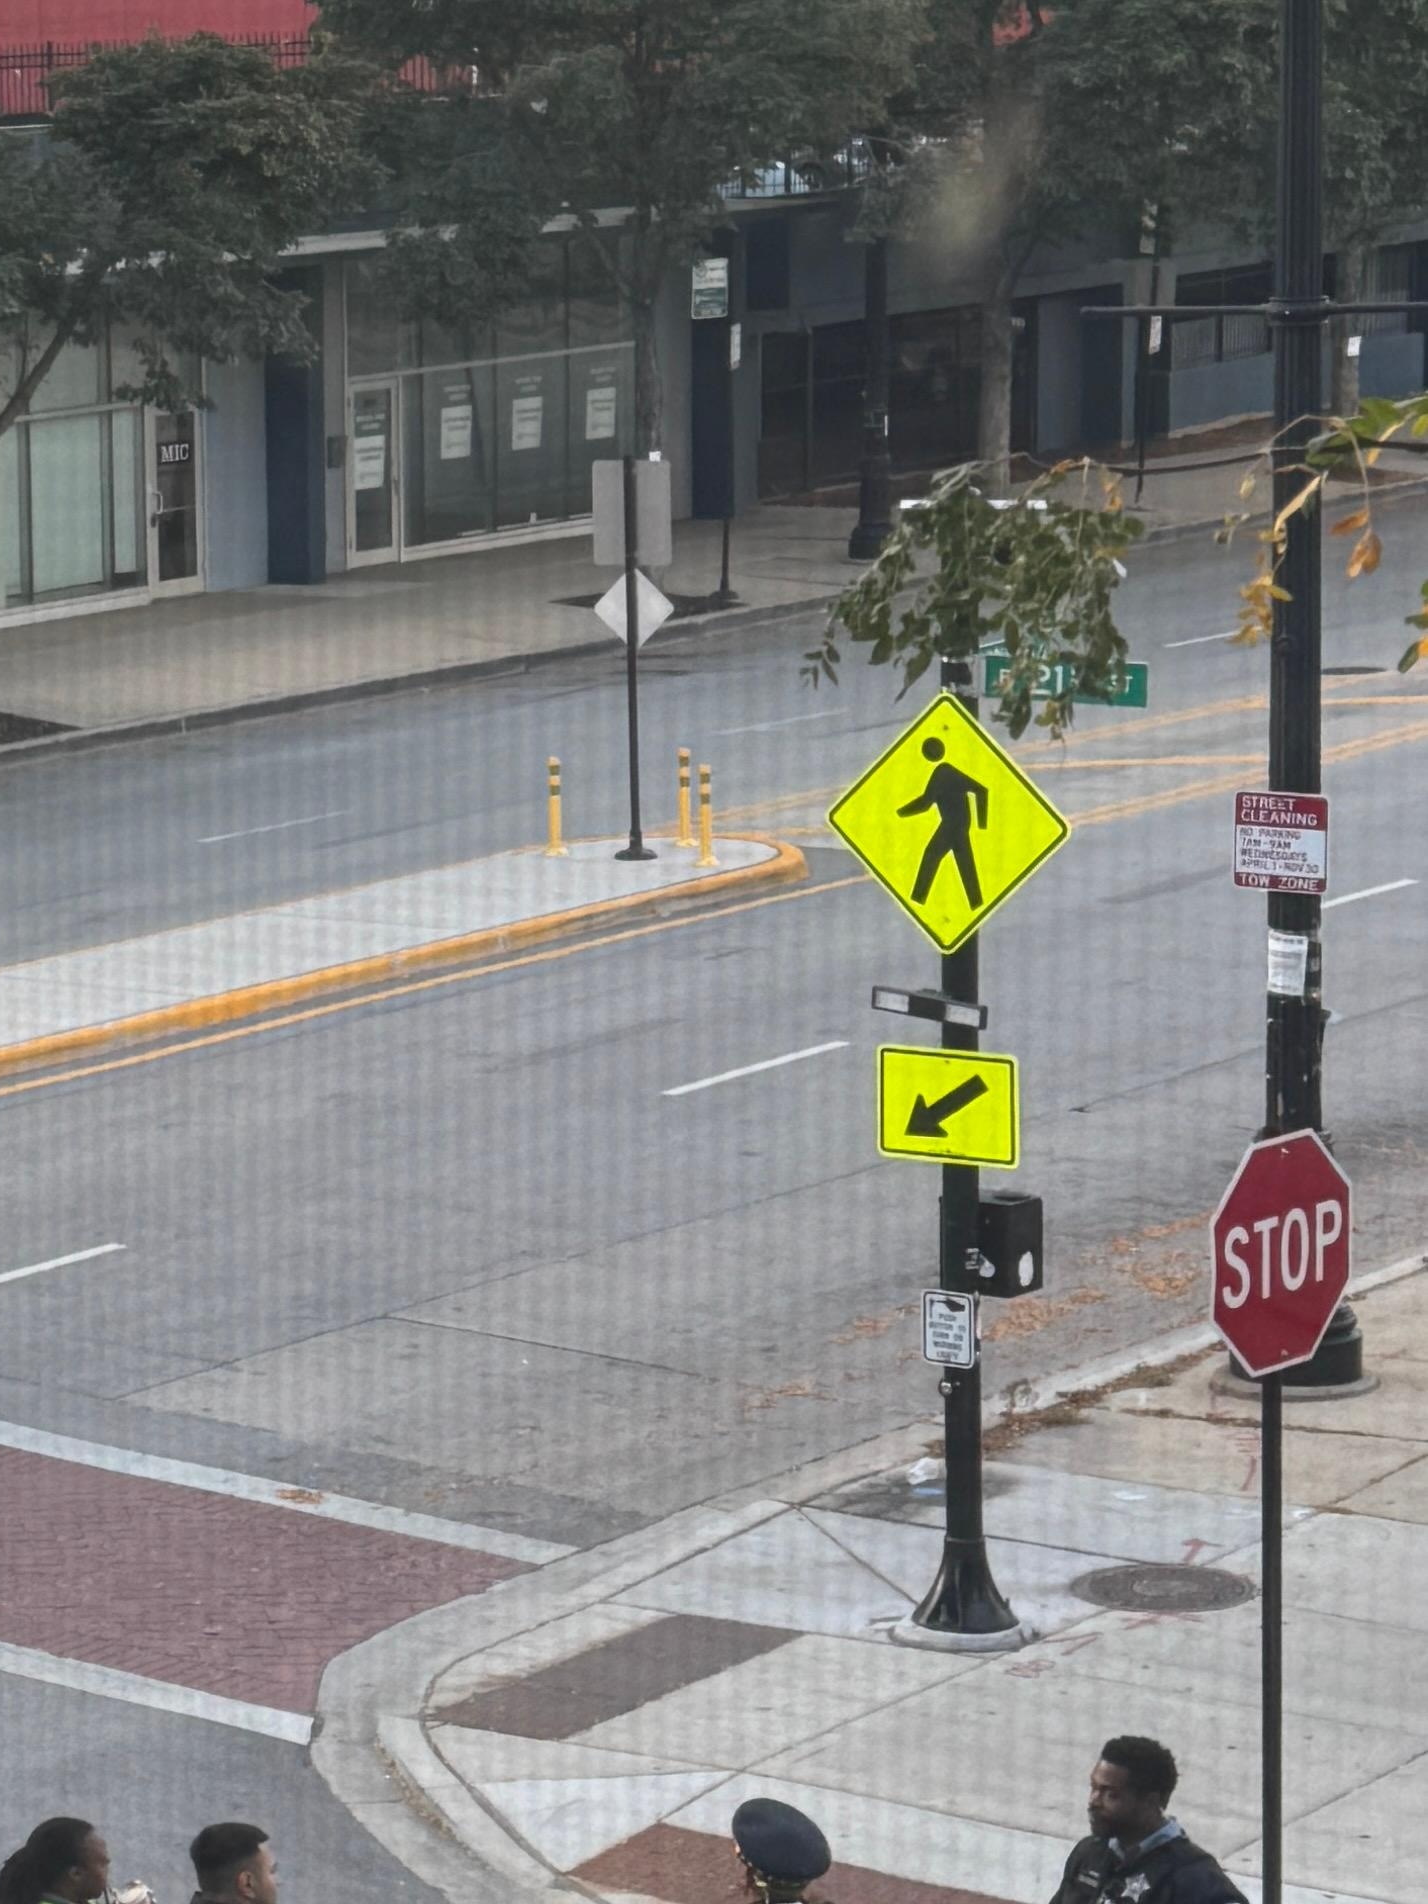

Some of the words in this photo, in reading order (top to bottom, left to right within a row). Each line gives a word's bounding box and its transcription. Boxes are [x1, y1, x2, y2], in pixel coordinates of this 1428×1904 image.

[161, 443, 189, 463] MIC
[1242, 795, 1296, 812] STREET
[1241, 809, 1318, 826] CLEANING
[1258, 828, 1302, 841] PARKING
[1239, 873, 1270, 887] TOW
[1278, 877, 1319, 891] ZONE
[1222, 1199, 1343, 1309] STOP
